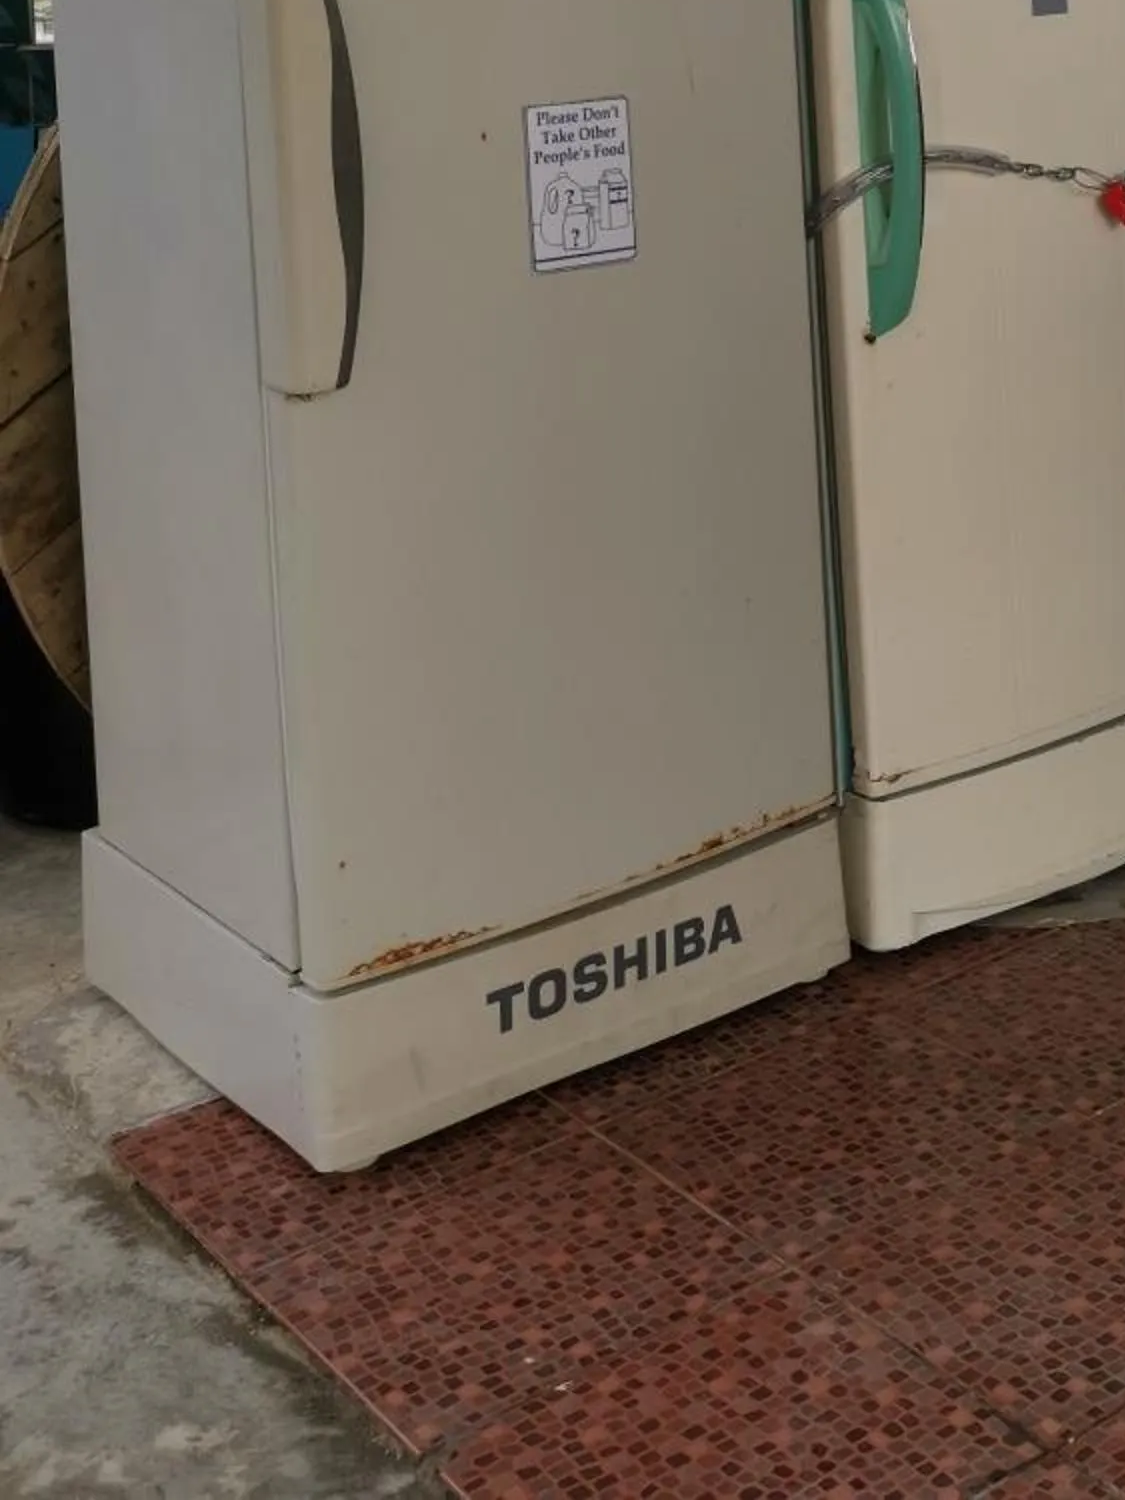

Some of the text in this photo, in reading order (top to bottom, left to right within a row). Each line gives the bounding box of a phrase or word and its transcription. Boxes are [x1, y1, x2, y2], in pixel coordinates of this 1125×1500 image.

[536, 106, 619, 126] Please Don't
[543, 125, 616, 144] Take Other
[534, 141, 625, 166] People's Food
[486, 904, 743, 1034] TOSHIBA
